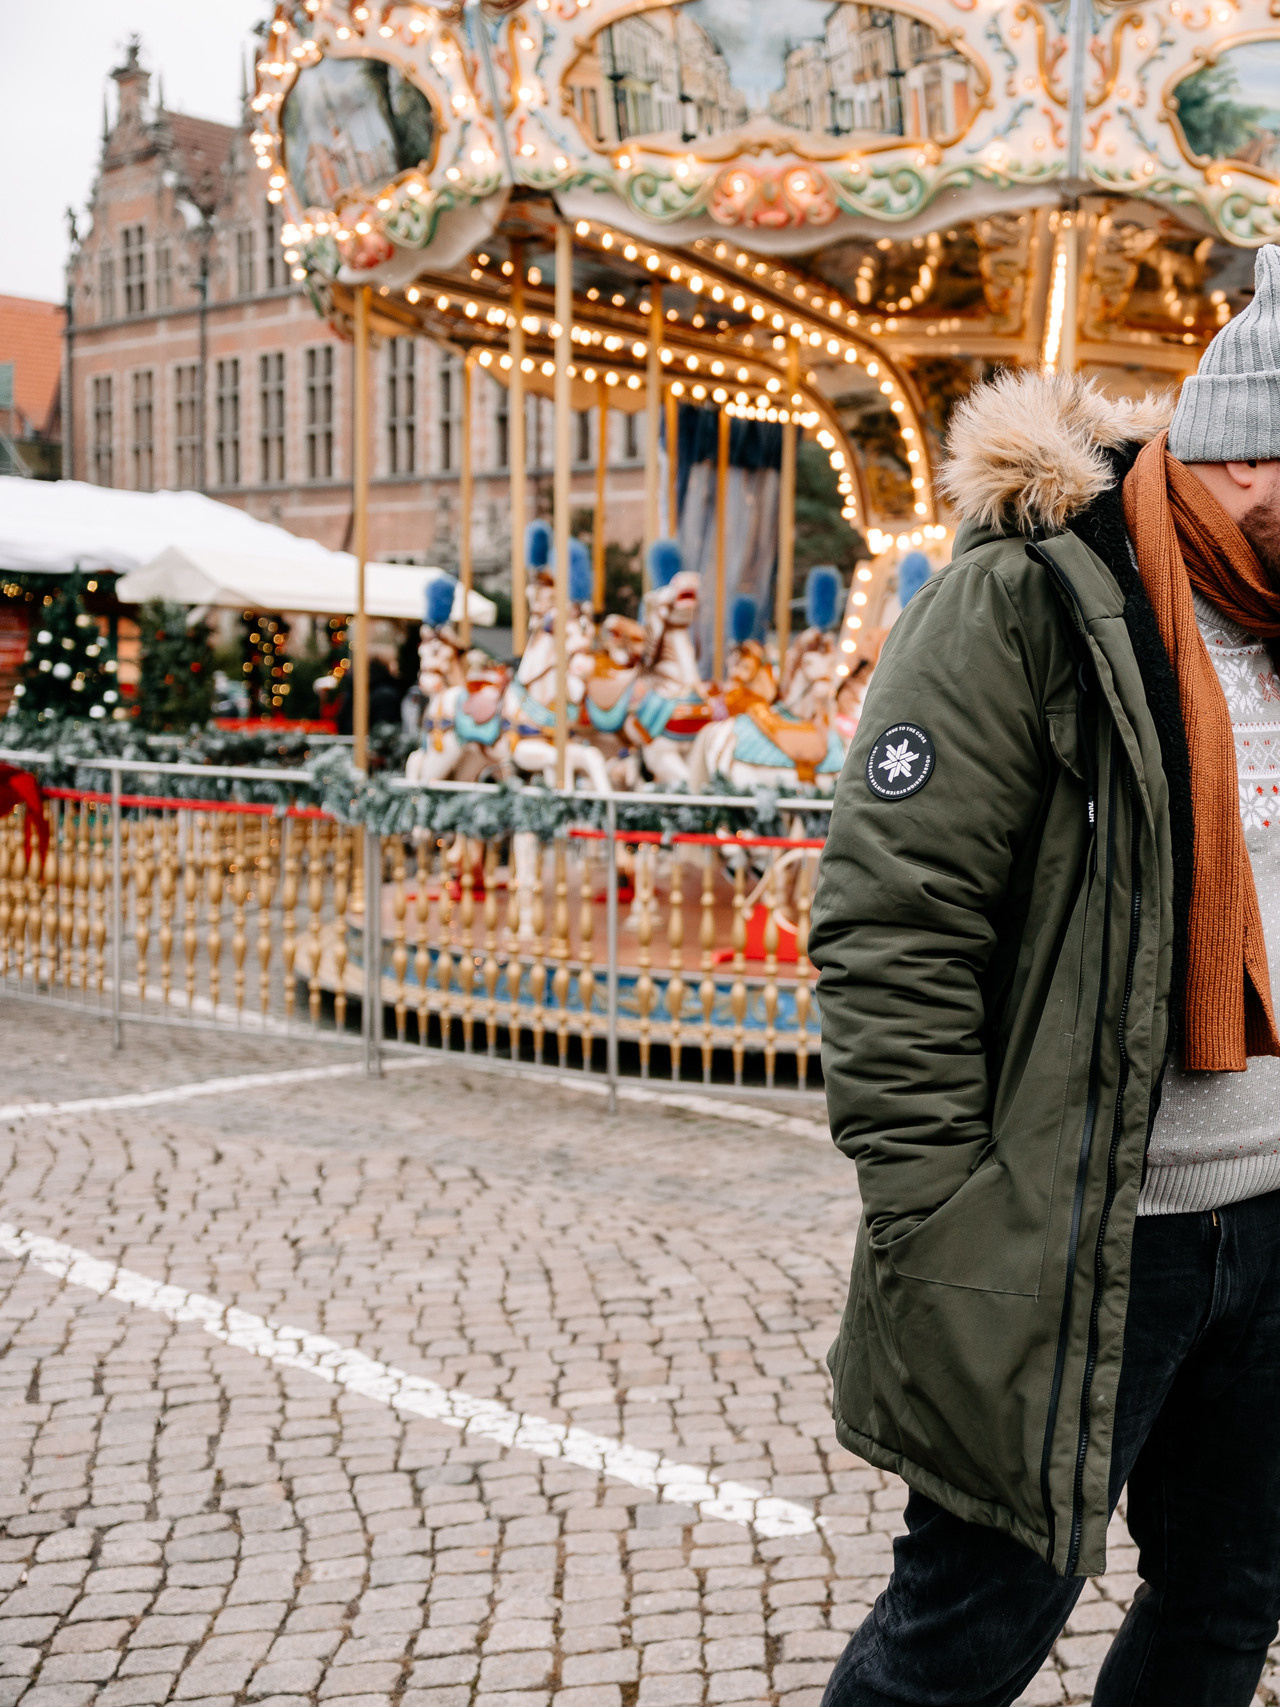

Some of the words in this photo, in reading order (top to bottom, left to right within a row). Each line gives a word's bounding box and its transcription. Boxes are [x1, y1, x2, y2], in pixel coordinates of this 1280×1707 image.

[906, 726, 916, 734] THE
[915, 731, 927, 744] CORE
[922, 754, 931, 775] HOUSE
[870, 778, 886, 794] WINTER
[906, 774, 925, 791] DESIGN
[886, 788, 907, 796] SYSTEM
